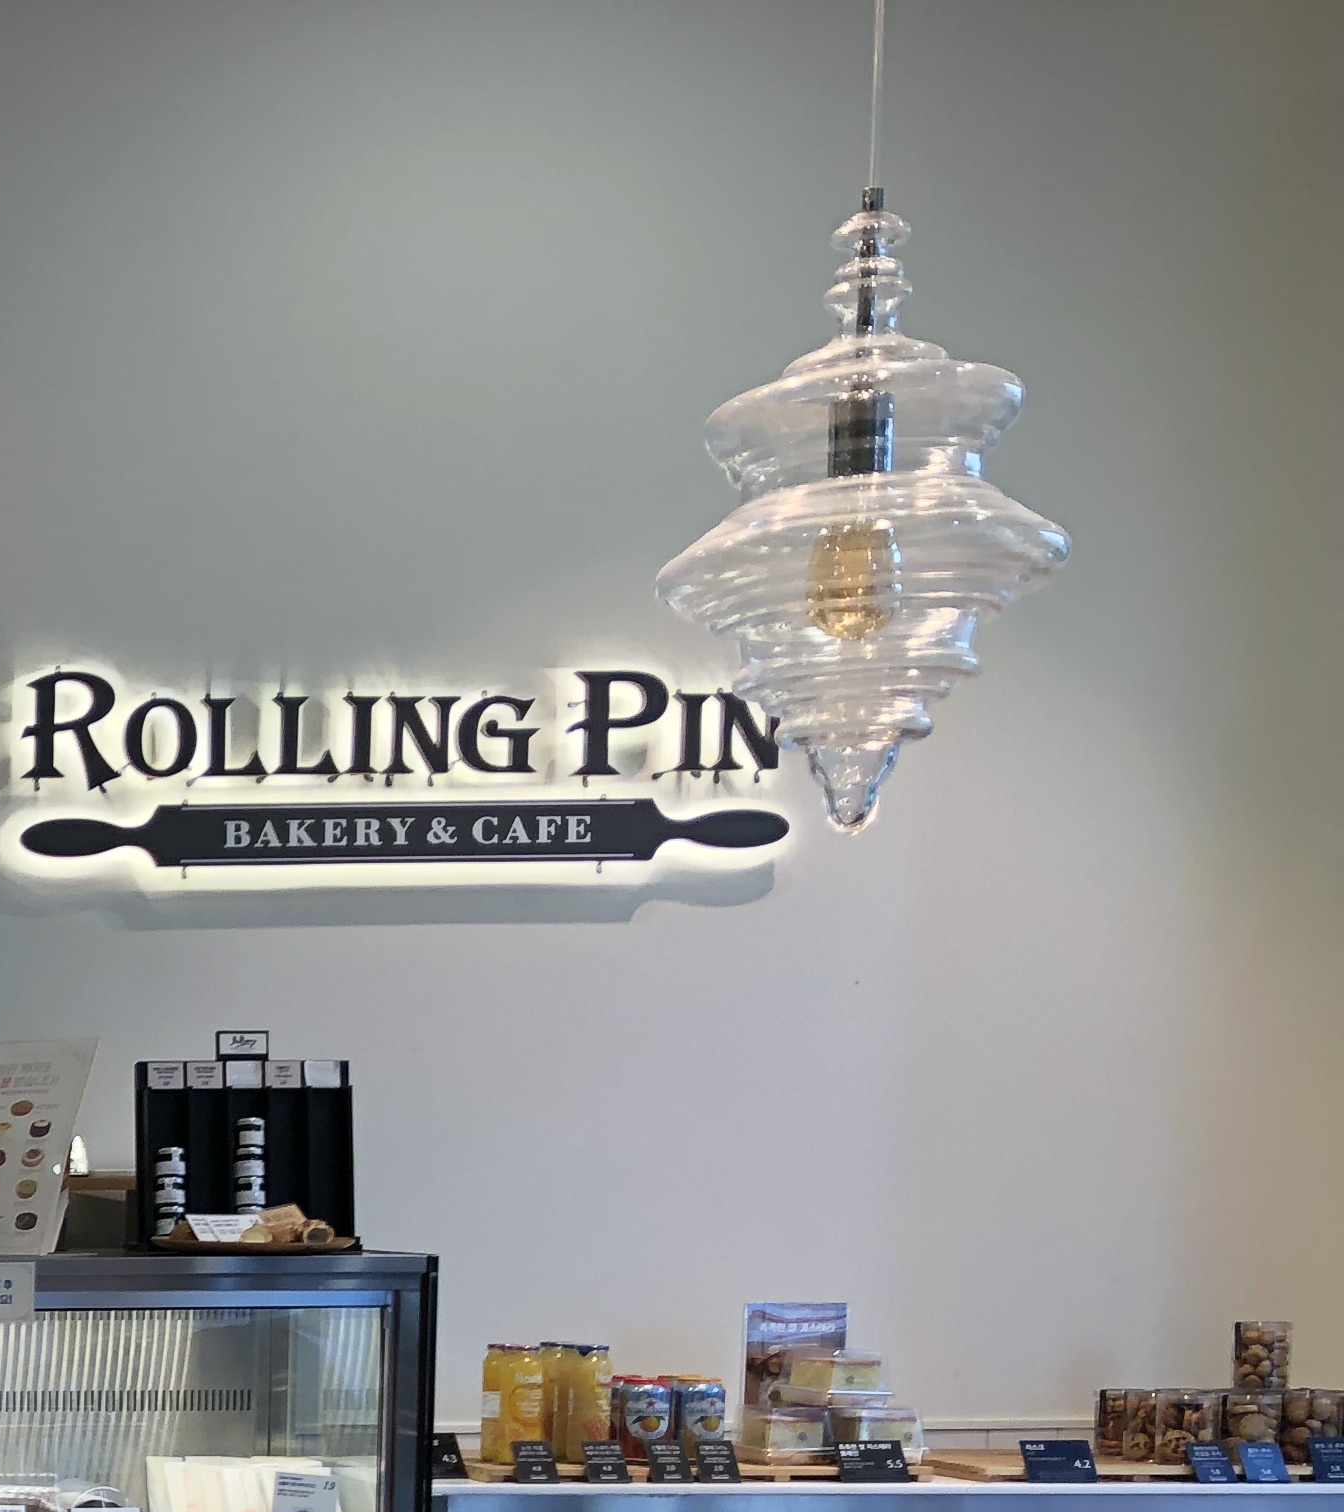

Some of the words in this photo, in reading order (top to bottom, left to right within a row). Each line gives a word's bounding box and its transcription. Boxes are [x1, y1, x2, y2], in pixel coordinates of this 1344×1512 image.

[21, 670, 540, 786] ROLLING
[571, 670, 781, 782] PIN
[223, 816, 412, 849] BAKERY
[427, 818, 457, 847] &
[472, 815, 593, 846] CAFE
[886, 1460, 903, 1468] 5.5
[1074, 1459, 1091, 1468] 4.2
